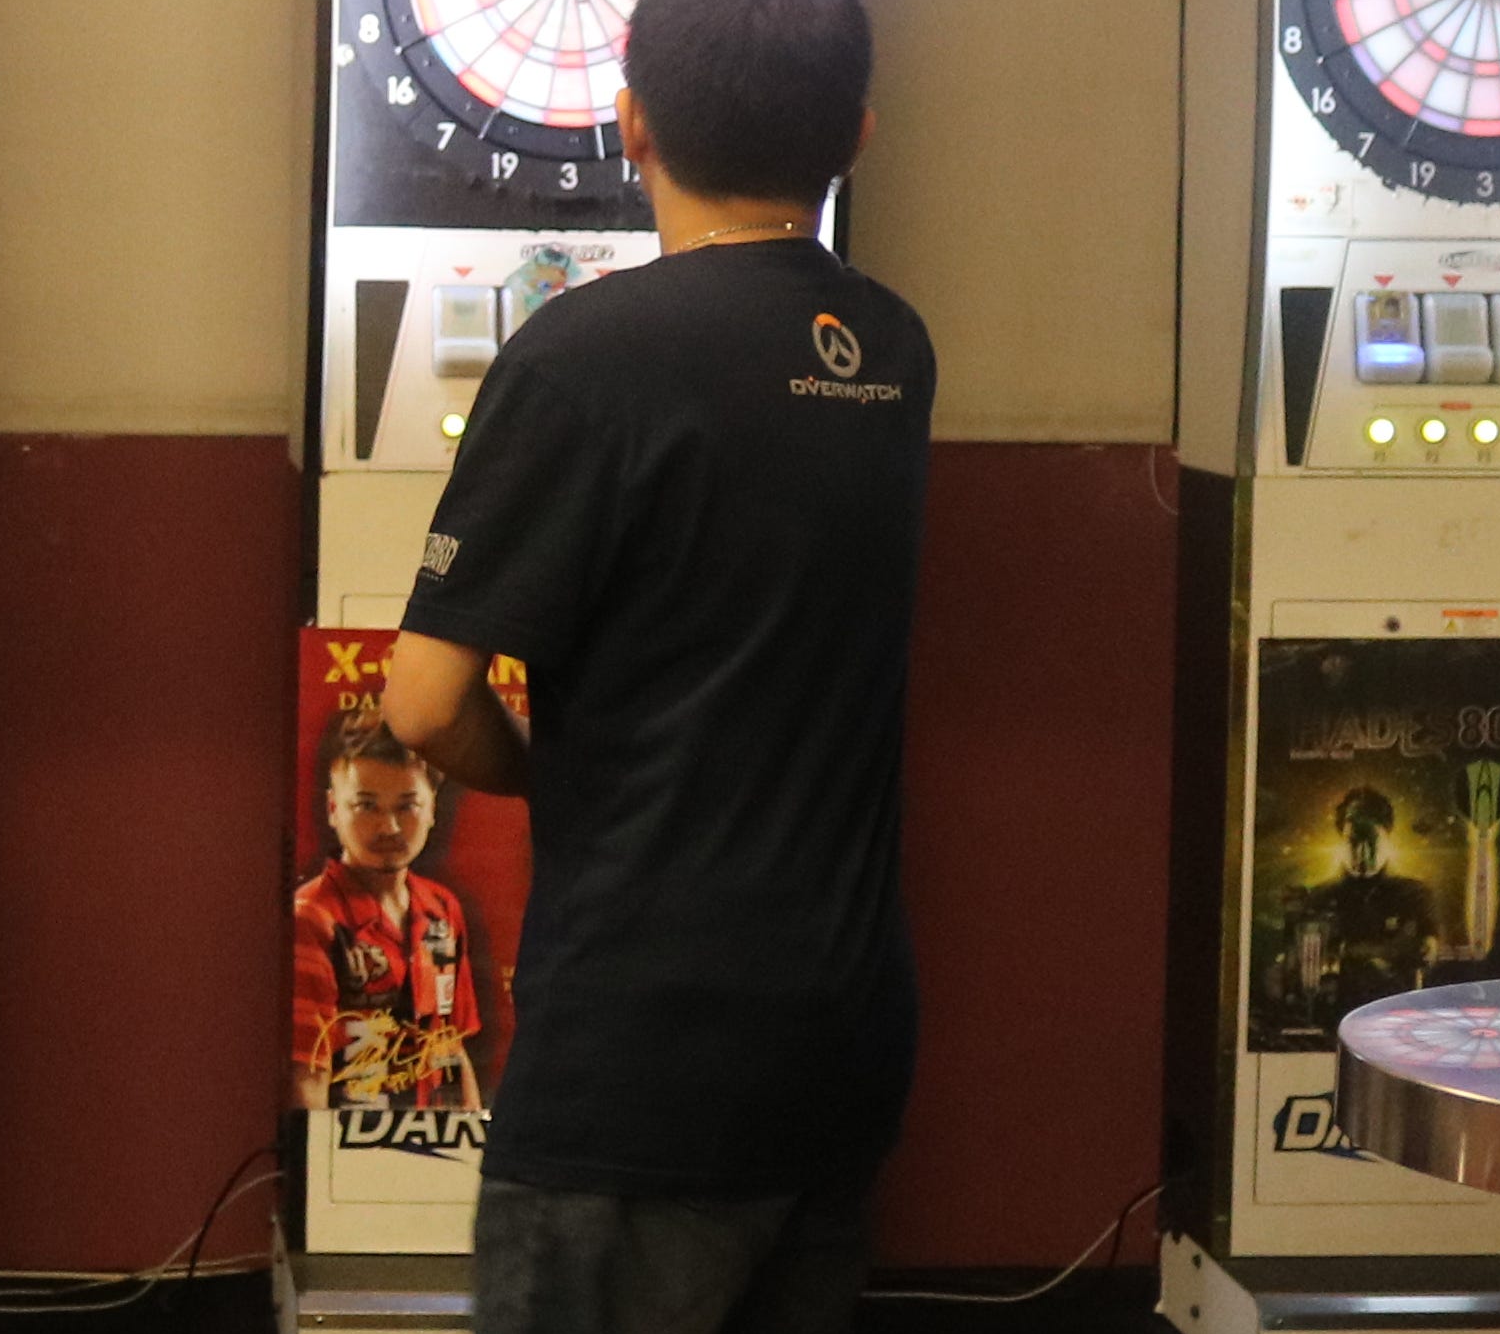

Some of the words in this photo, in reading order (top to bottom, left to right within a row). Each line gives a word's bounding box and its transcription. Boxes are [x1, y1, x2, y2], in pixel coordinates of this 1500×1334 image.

[359, 15, 379, 42] 8
[1284, 27, 1301, 53] 8
[388, 77, 415, 104] 16
[1313, 88, 1335, 113] 16
[438, 123, 455, 149] 7
[1359, 133, 1374, 157] 7
[492, 153, 518, 178] 19
[561, 163, 577, 189] 3
[1412, 162, 1435, 186] 19
[1478, 172, 1493, 196] 3
[789, 375, 903, 404] OVERWATCH
